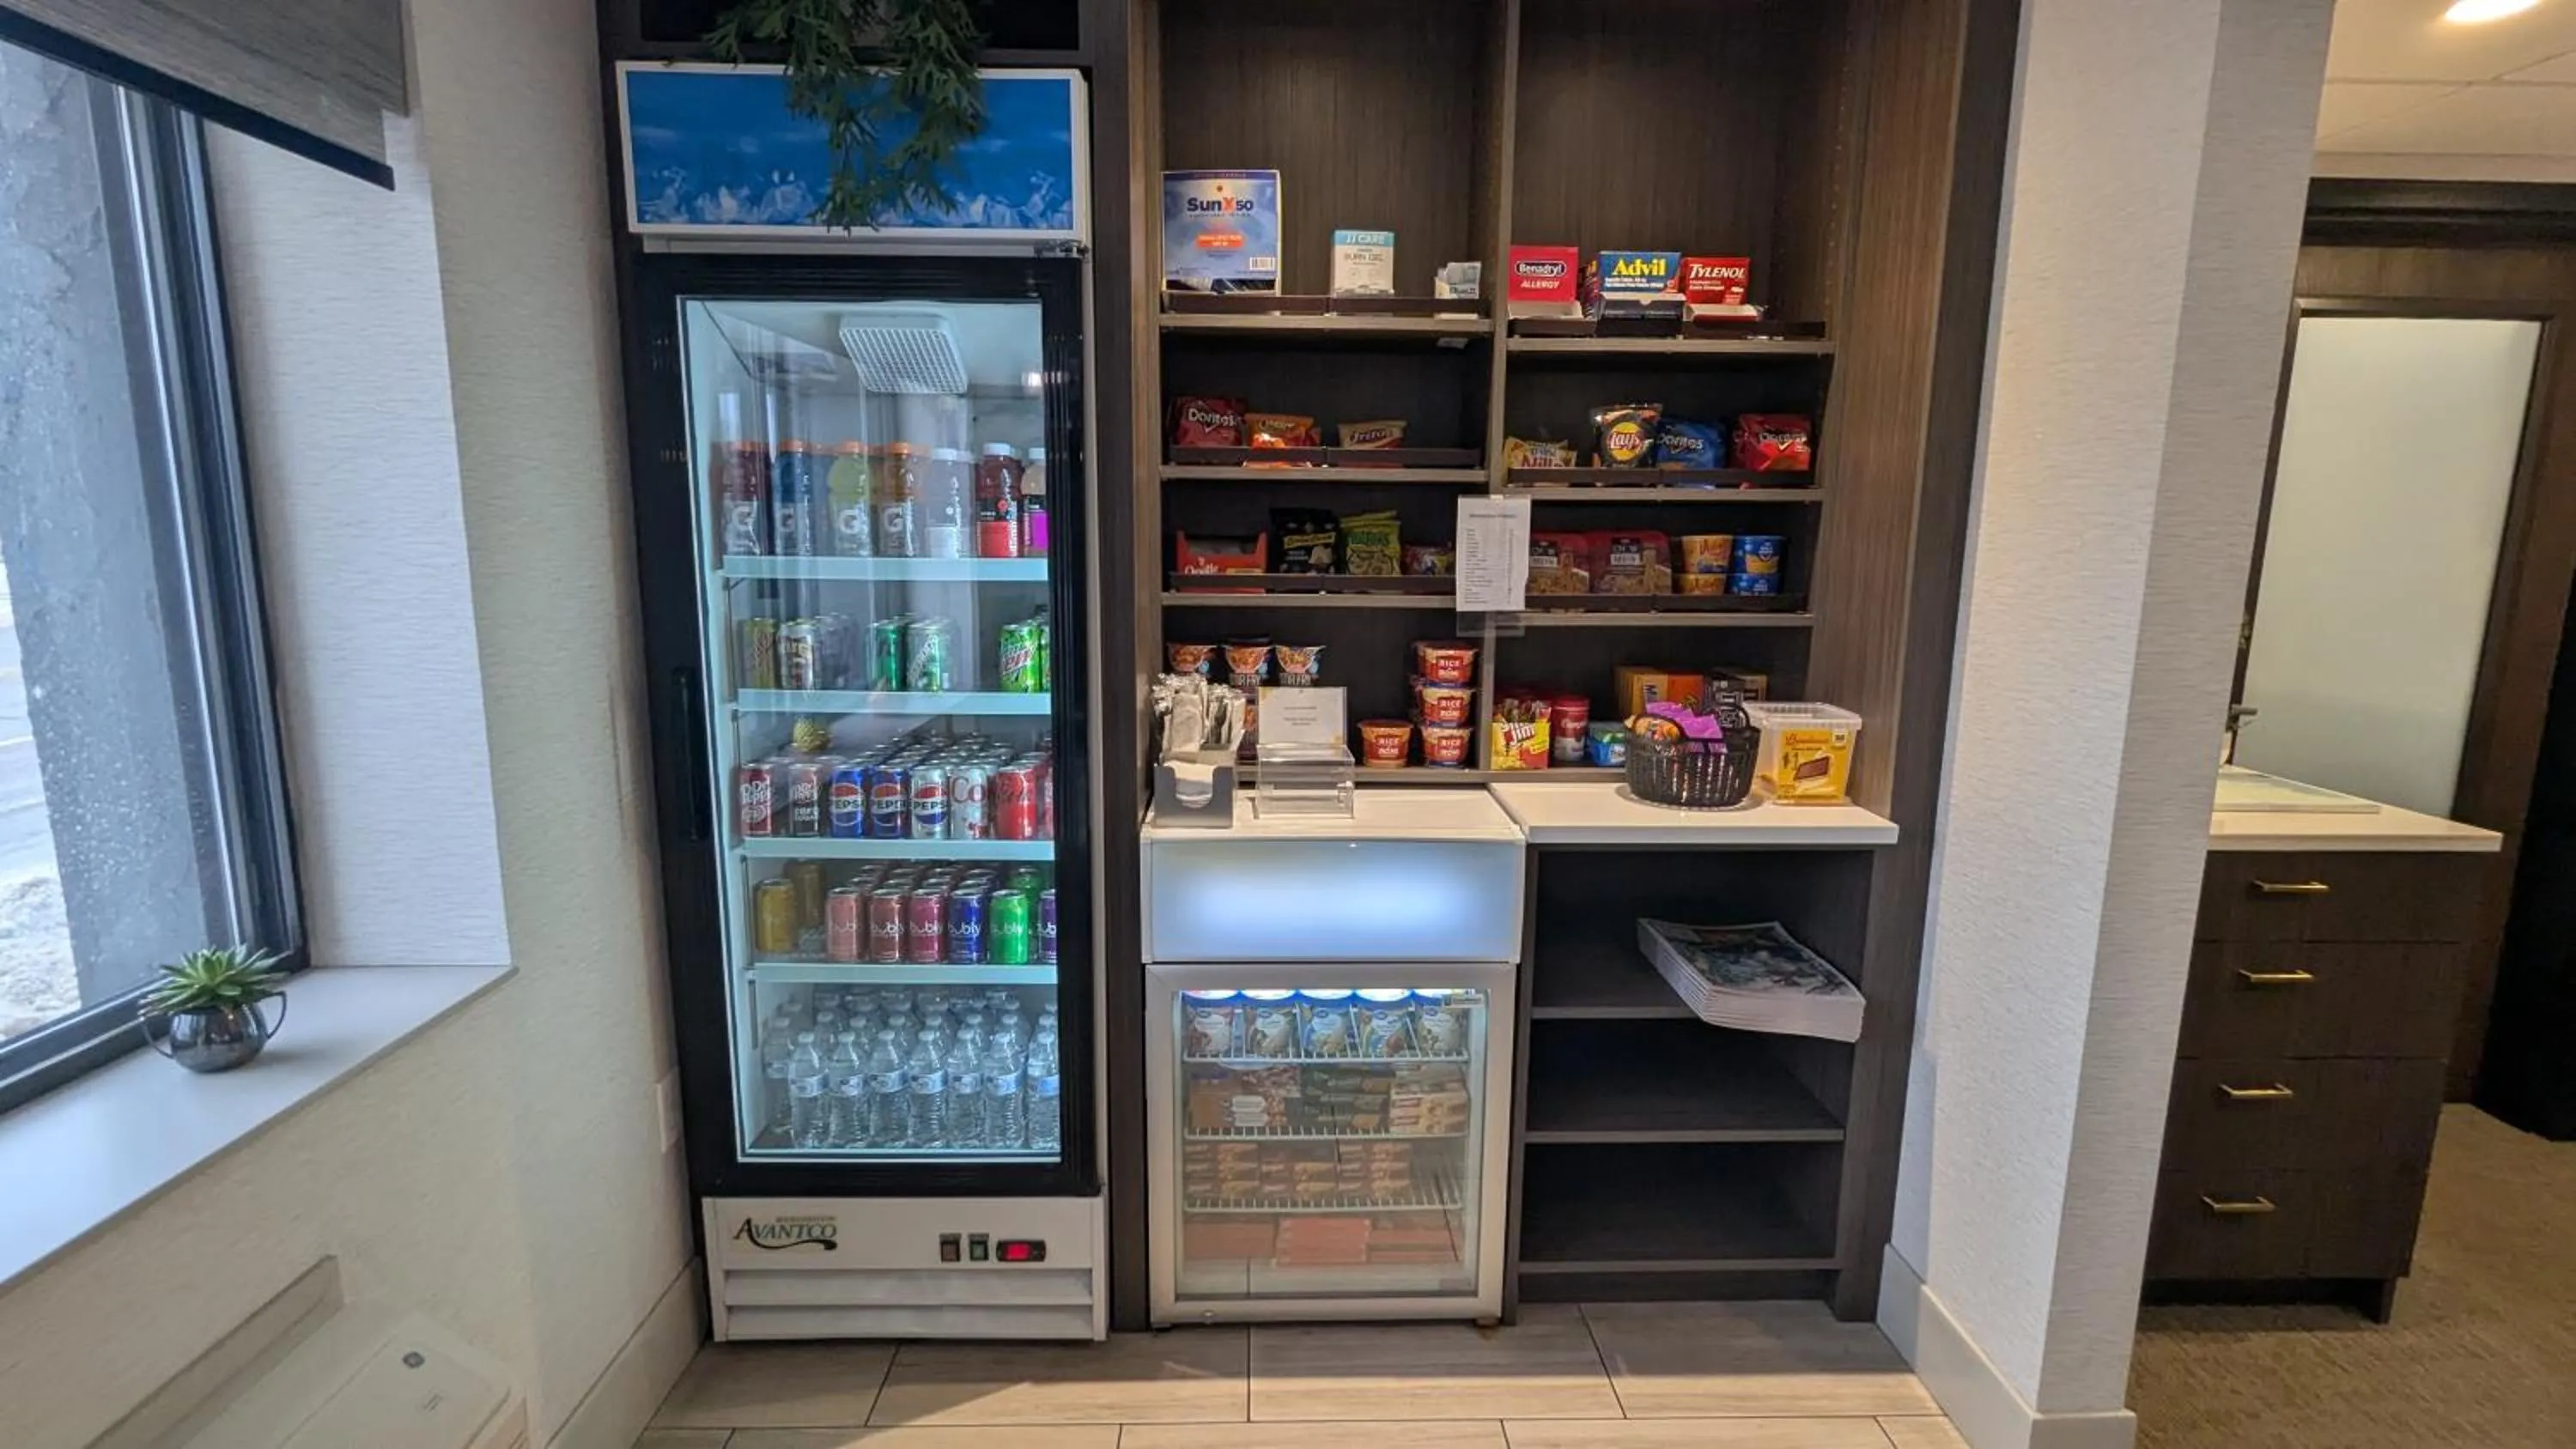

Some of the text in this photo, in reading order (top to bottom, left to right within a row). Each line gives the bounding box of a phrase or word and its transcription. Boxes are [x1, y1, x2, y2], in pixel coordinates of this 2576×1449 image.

[1519, 264, 1562, 276] Benadryl
[1612, 258, 1667, 276] Advil
[1689, 264, 1746, 279] TYLENOL
[1521, 280, 1560, 289] ALLERGY
[1188, 408, 1238, 427] Doritos
[1437, 658, 1460, 668] RICE
[1440, 699, 1461, 708] RICE
[1510, 725, 1535, 746] Jim
[1377, 737, 1399, 746] RICE
[1441, 737, 1461, 747] RICE
[831, 799, 866, 810] EPSI
[873, 799, 908, 809] EPSI
[913, 800, 948, 810] PEPS
[948, 921, 981, 937] bubly
[733, 1217, 837, 1243] AVANTCO
